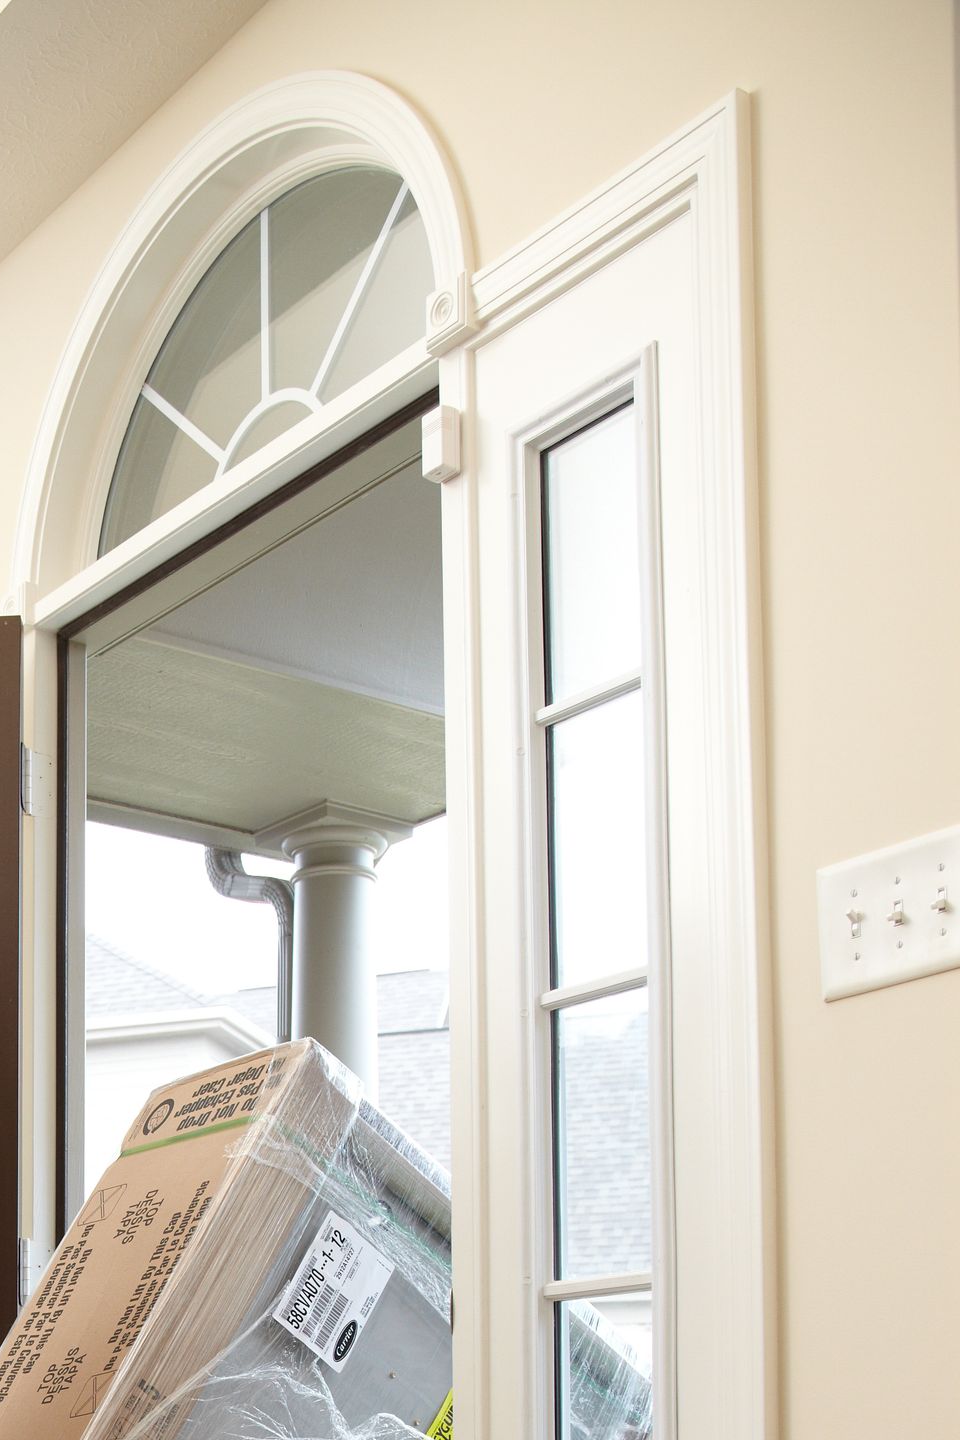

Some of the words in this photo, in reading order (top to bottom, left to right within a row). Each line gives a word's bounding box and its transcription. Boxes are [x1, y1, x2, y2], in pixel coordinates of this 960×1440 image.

[226, 1064, 266, 1087] Dejar
[192, 1078, 226, 1098] Caer
[237, 1082, 262, 1099] Pas
[174, 1089, 237, 1118] Echapper
[213, 1103, 240, 1121] Not
[177, 1113, 210, 1131] Drop
[113, 1201, 141, 1239] TAPA
[121, 1189, 158, 1245] DESSUS
[144, 1198, 164, 1227] TOP
[59, 1245, 74, 1261] No
[71, 1240, 87, 1262] Pas
[79, 1248, 93, 1264] Do
[70, 1266, 85, 1286] Not
[107, 1329, 122, 1344] Do
[118, 1304, 135, 1327] Not
[129, 1282, 147, 1303] Lift
[141, 1262, 157, 1281] By
[150, 1237, 169, 1263] This
[163, 1211, 182, 1235] Cap
[113, 1331, 131, 1356] Pas
[126, 1279, 158, 1330] Soulever
[155, 1255, 172, 1277] Par
[166, 1239, 180, 1253] Le
[176, 1179, 210, 1237] Couvercle
[36, 1262, 61, 1309] Levantar
[46, 1262, 77, 1309] Soulever
[62, 1287, 74, 1307] Lift
[24, 1311, 40, 1332] Por
[35, 1312, 51, 1332] Par
[52, 1309, 64, 1325] By
[7, 1333, 28, 1357] Esta
[25, 1333, 40, 1348] Le
[39, 1327, 55, 1351] This
[336, 1324, 355, 1357] Carrier
[22, 1353, 40, 1374] Cap
[58, 1352, 87, 1393] TAPA
[37, 1363, 58, 1393] TOP
[41, 1346, 80, 1405] DESSUS
